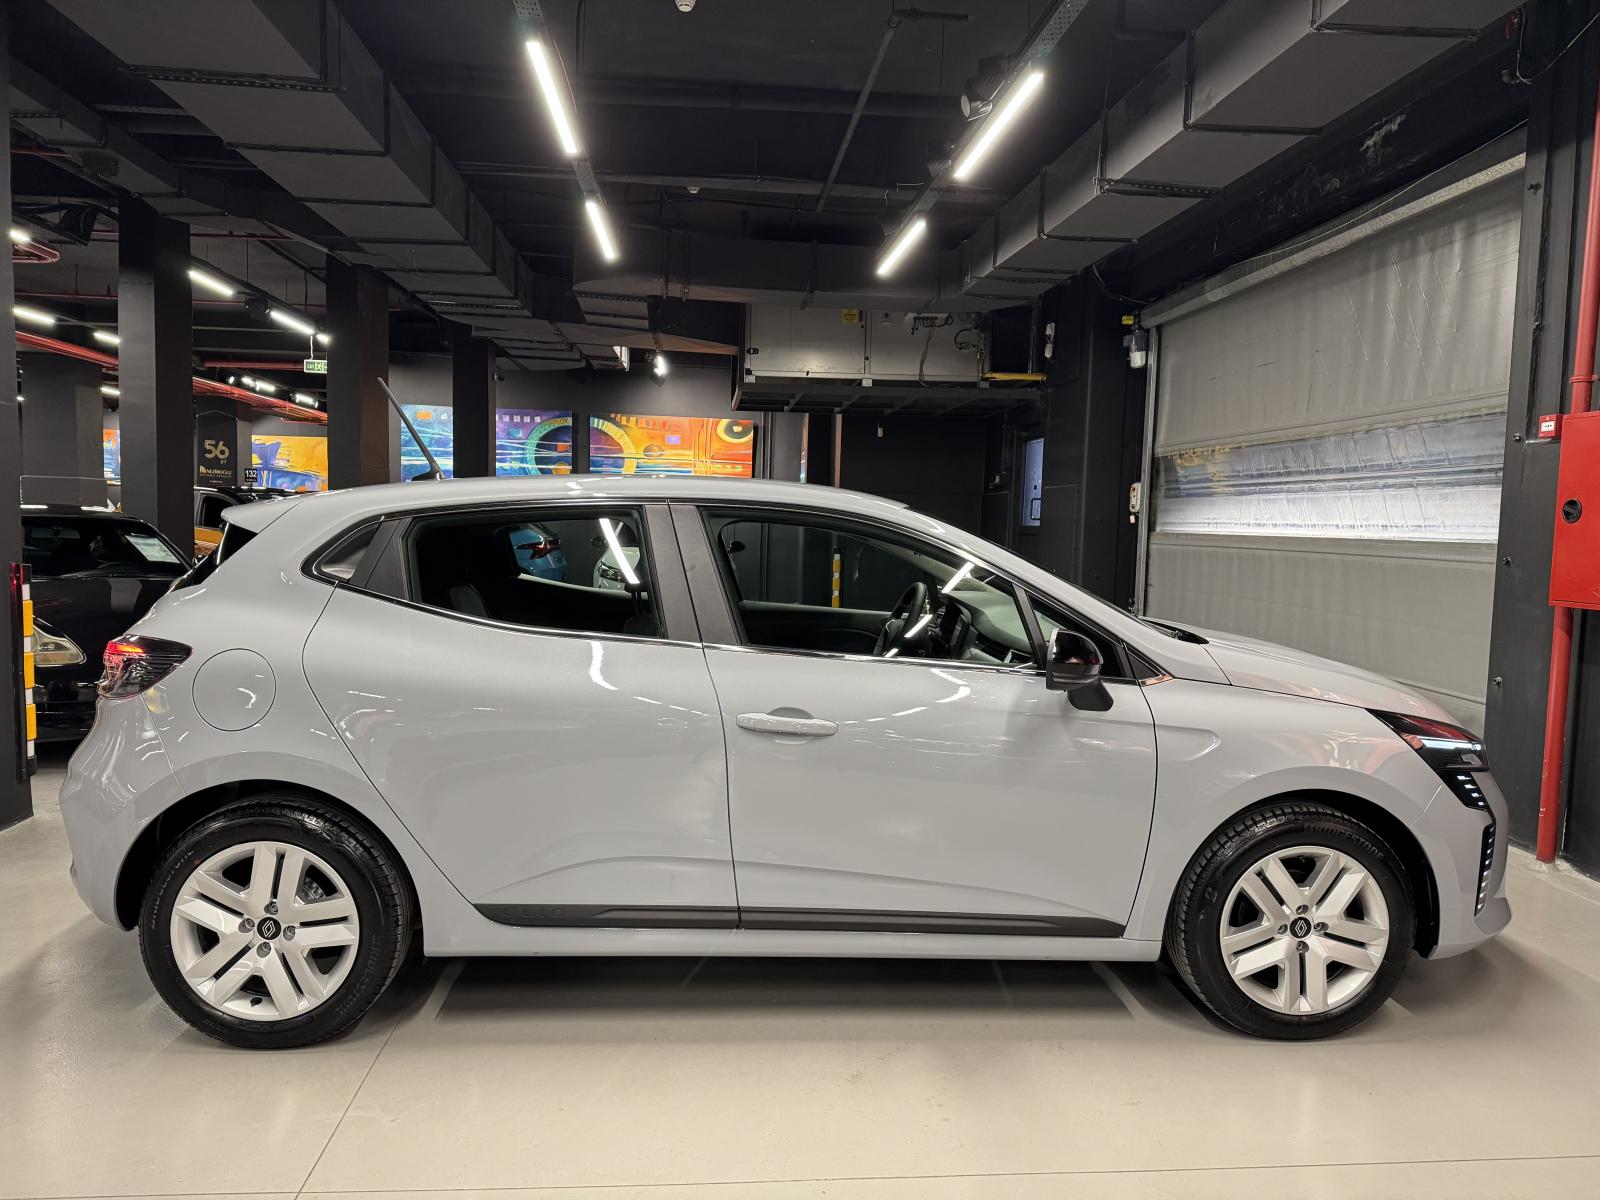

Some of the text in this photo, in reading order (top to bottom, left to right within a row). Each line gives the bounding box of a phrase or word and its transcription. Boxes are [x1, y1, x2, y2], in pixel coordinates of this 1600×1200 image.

[204, 439, 229, 459] 56
[245, 469, 257, 478] 132
[503, 906, 566, 919] CLIO
